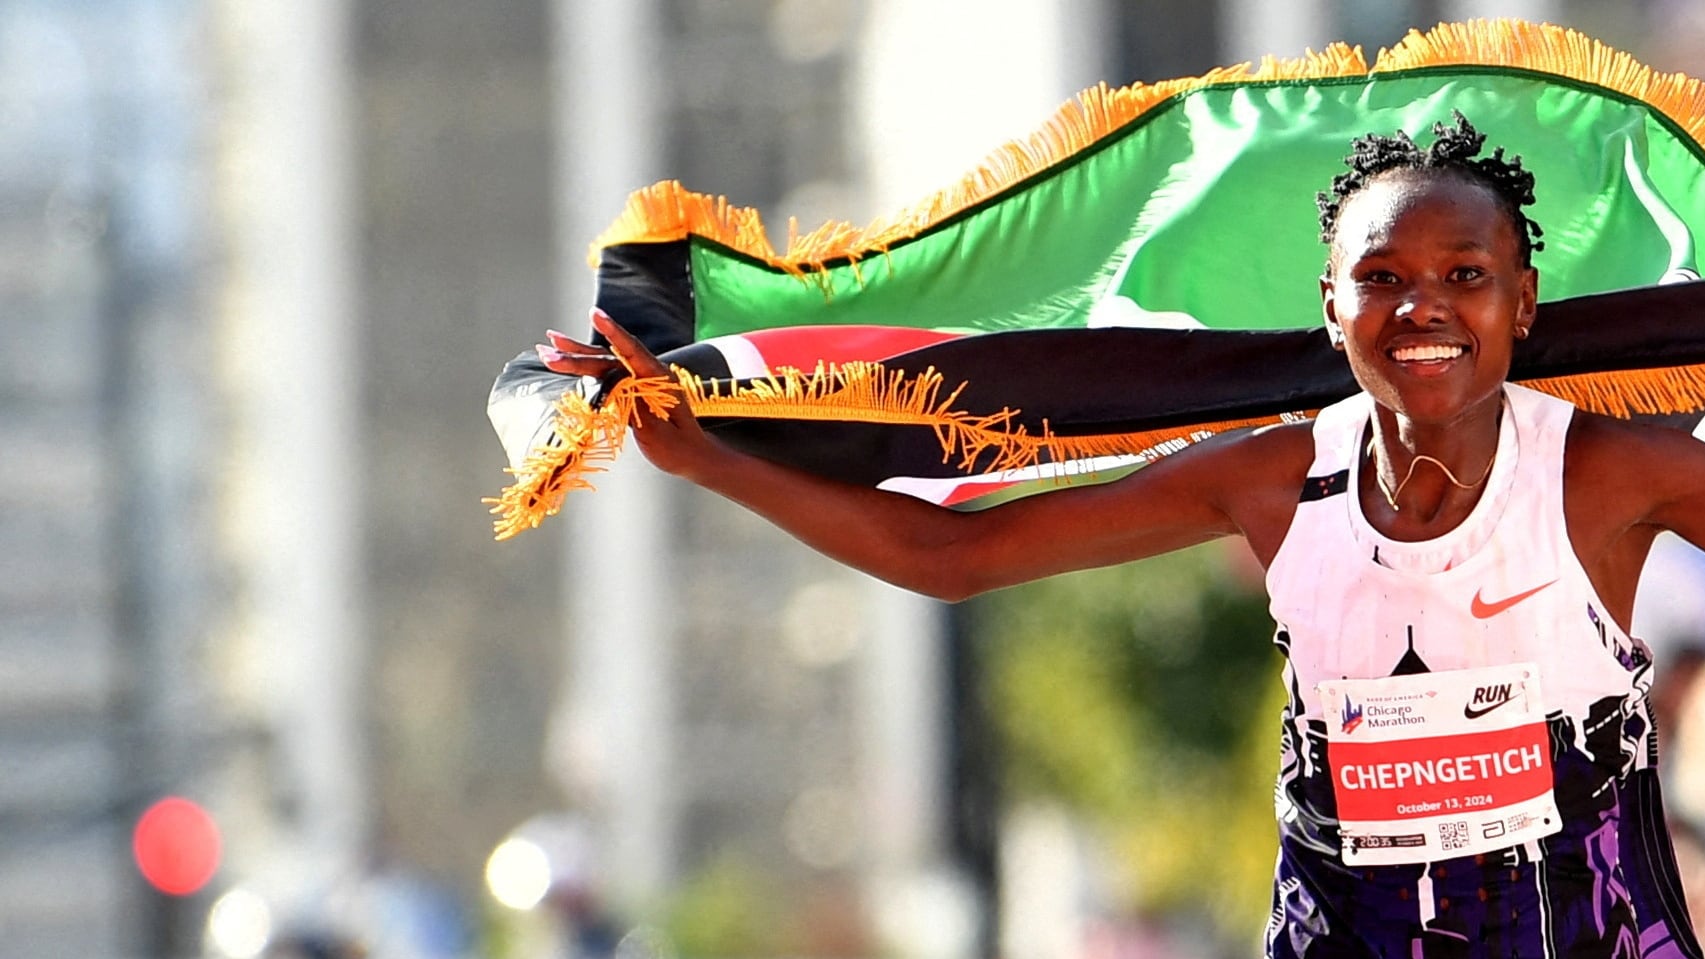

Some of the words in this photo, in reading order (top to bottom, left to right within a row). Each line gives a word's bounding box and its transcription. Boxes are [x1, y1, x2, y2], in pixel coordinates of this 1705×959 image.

[1473, 683, 1512, 704] RUN
[1367, 704, 1412, 717] Chicago
[1368, 712, 1425, 728] Marathon
[1340, 744, 1543, 790] CHEPNGETICH
[1397, 800, 1441, 815] October
[1444, 798, 1463, 810] 13,
[1464, 794, 1493, 807] 2024
